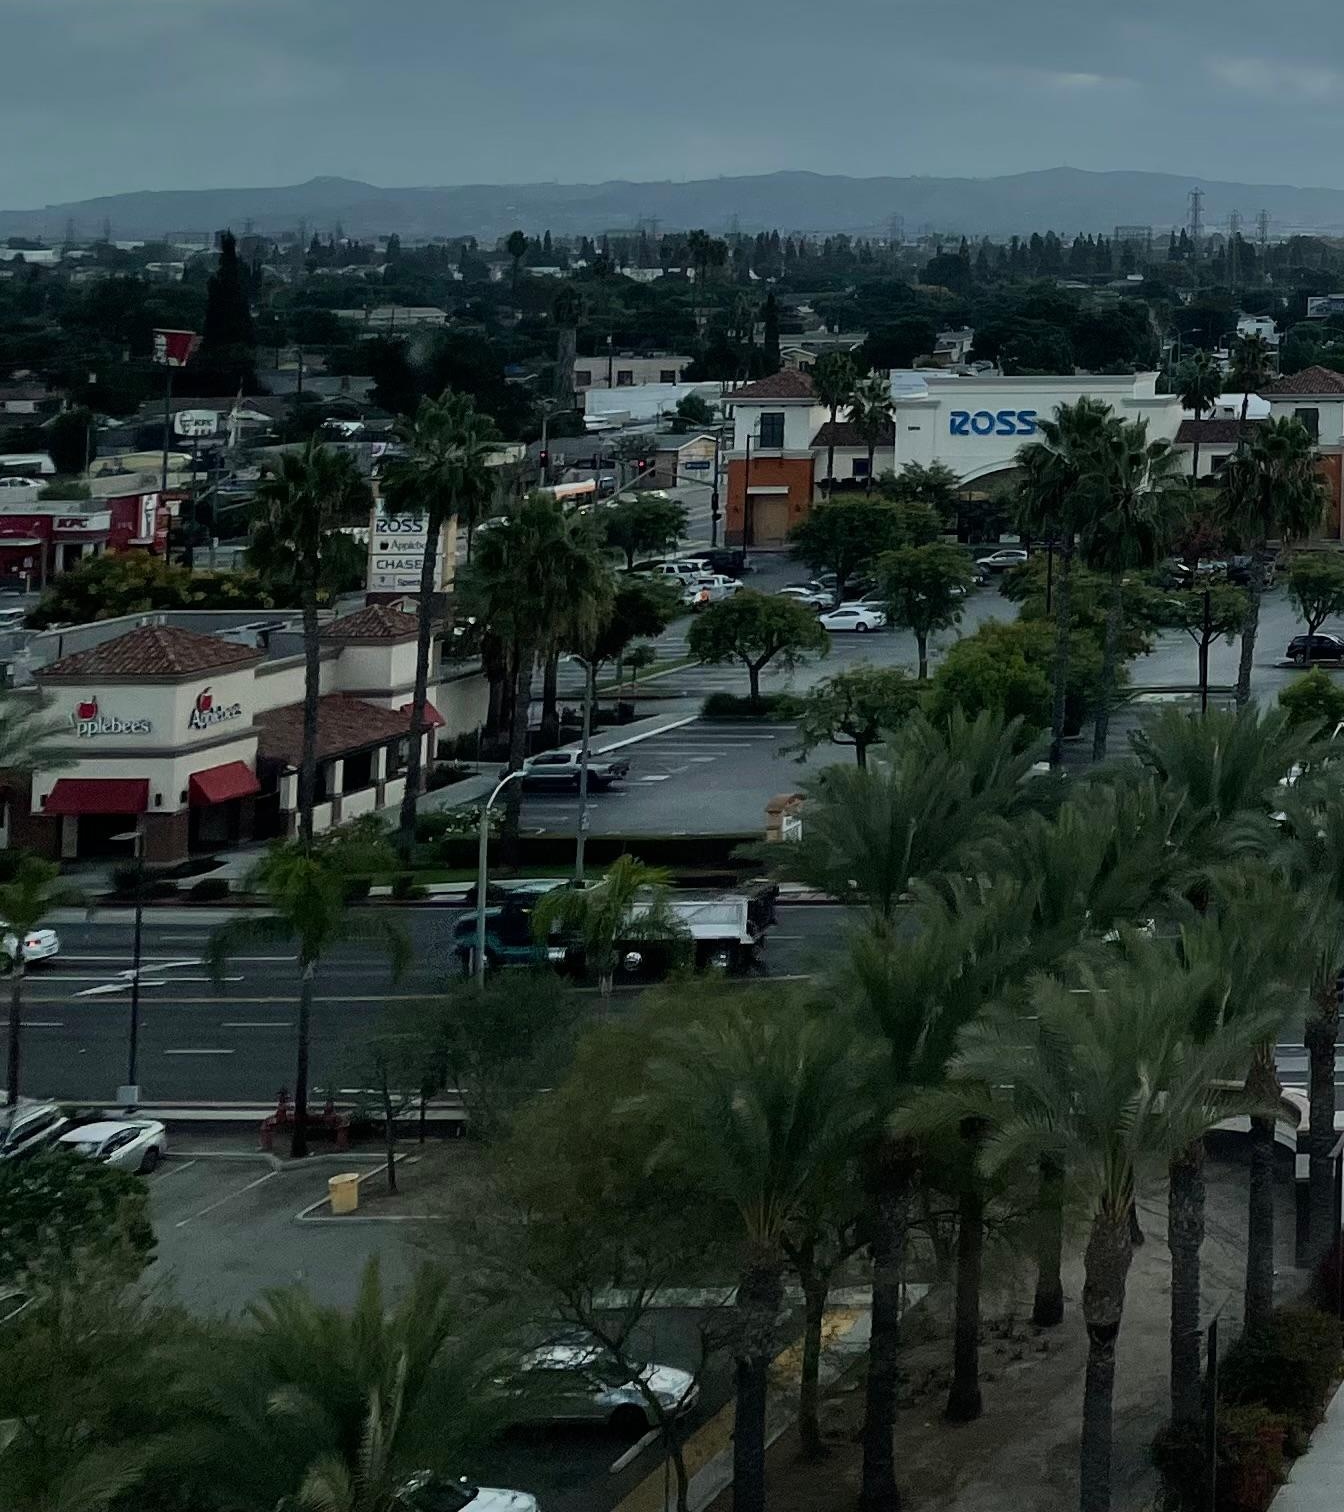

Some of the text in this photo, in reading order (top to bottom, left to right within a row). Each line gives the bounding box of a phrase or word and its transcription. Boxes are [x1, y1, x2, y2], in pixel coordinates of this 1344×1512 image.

[950, 410, 1037, 435] ROSS
[375, 518, 424, 533] ROSS
[376, 559, 423, 570] CHASE
